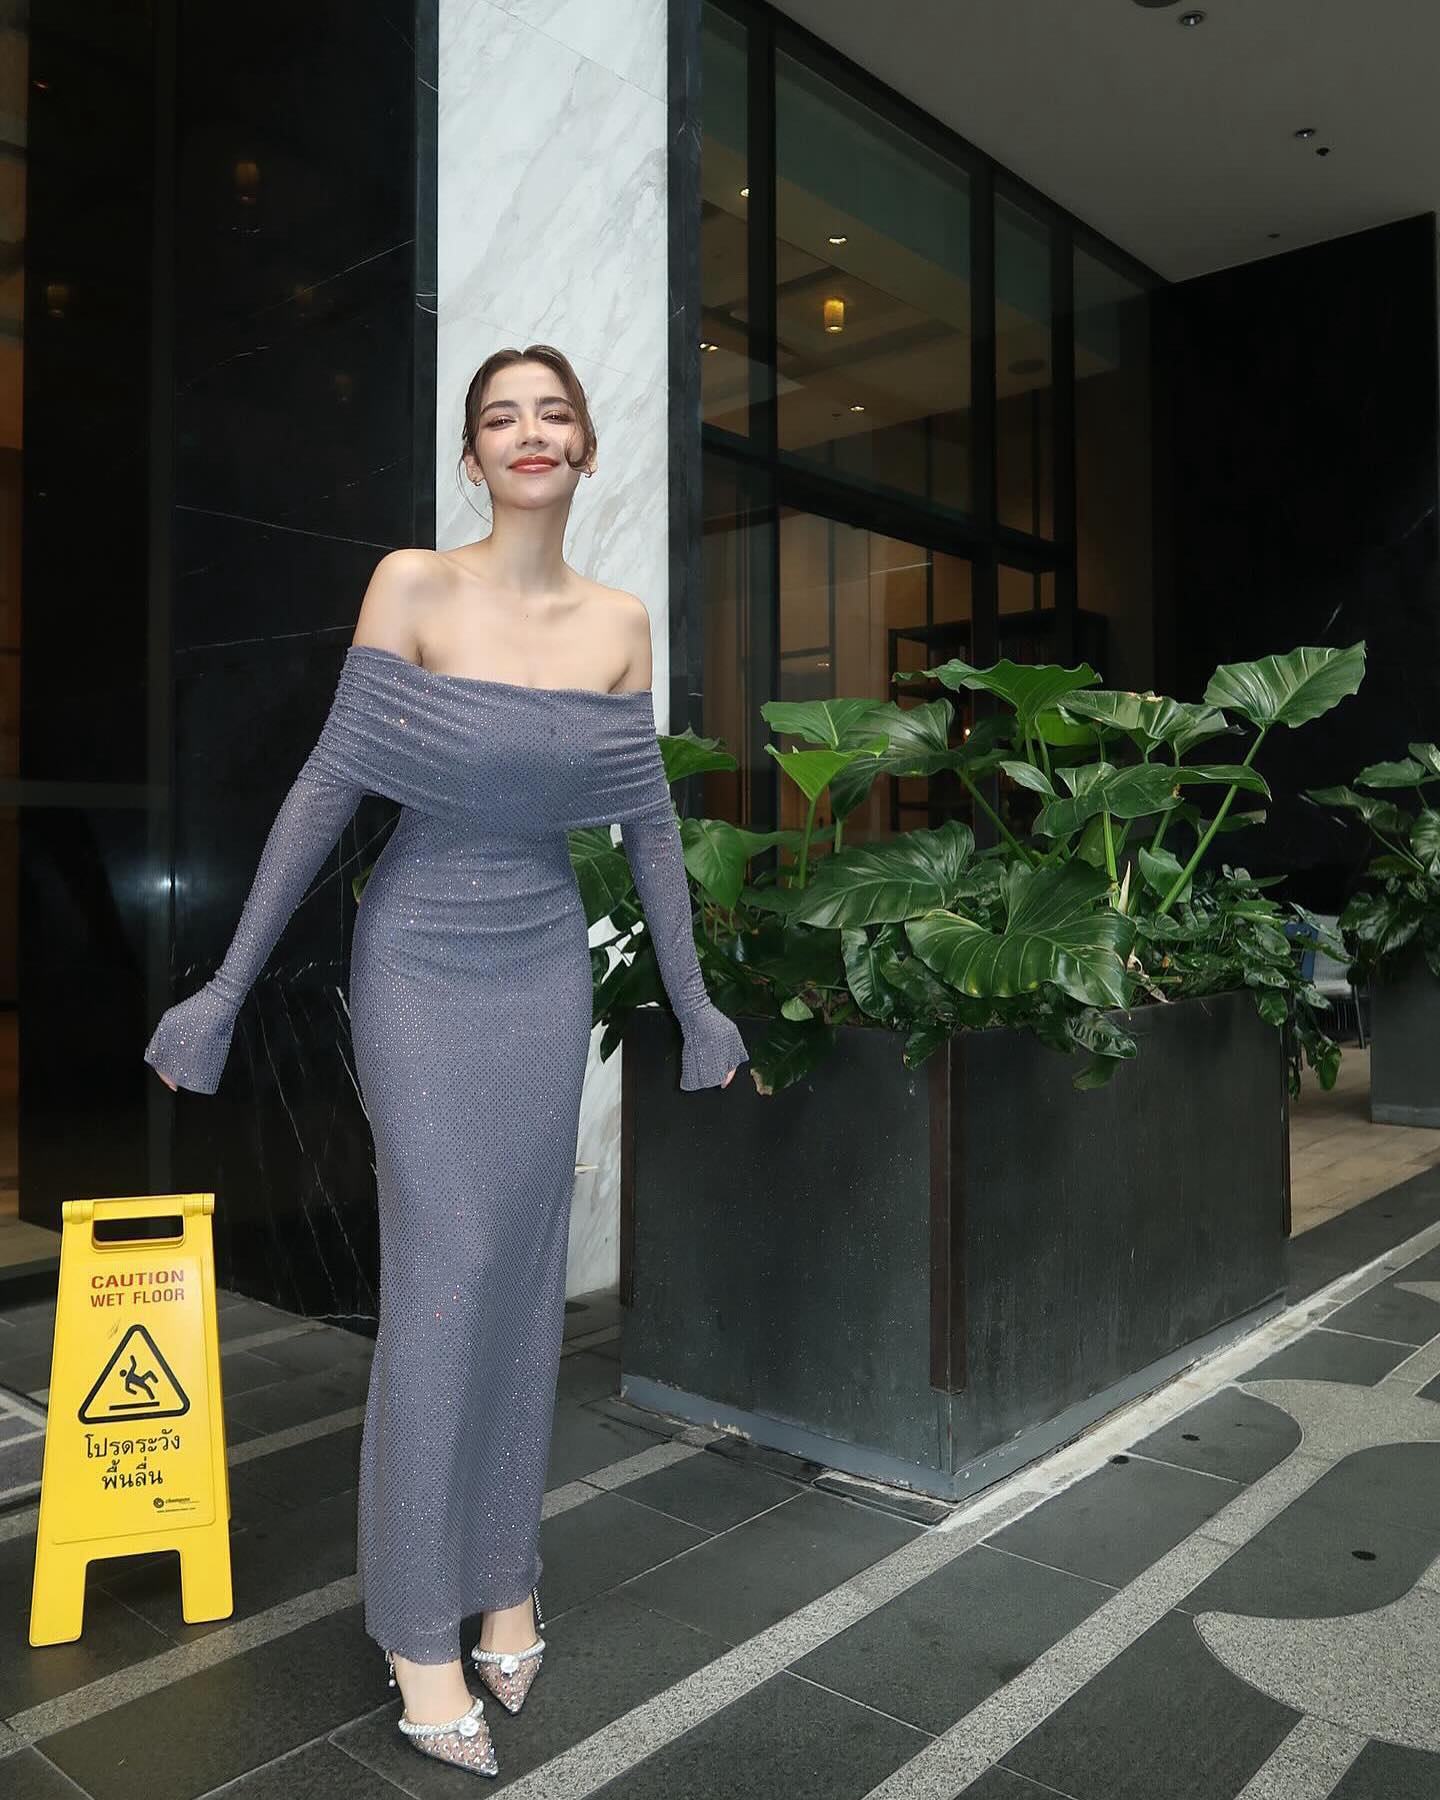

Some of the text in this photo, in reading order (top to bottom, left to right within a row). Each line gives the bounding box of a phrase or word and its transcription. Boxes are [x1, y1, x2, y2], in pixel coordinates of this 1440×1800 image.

[91, 1269, 184, 1289] CAUTION
[90, 1288, 184, 1307] WET FLOOR
[84, 1428, 180, 1458] โปรดระวัง
[102, 1456, 163, 1489] พื้นลื่น
